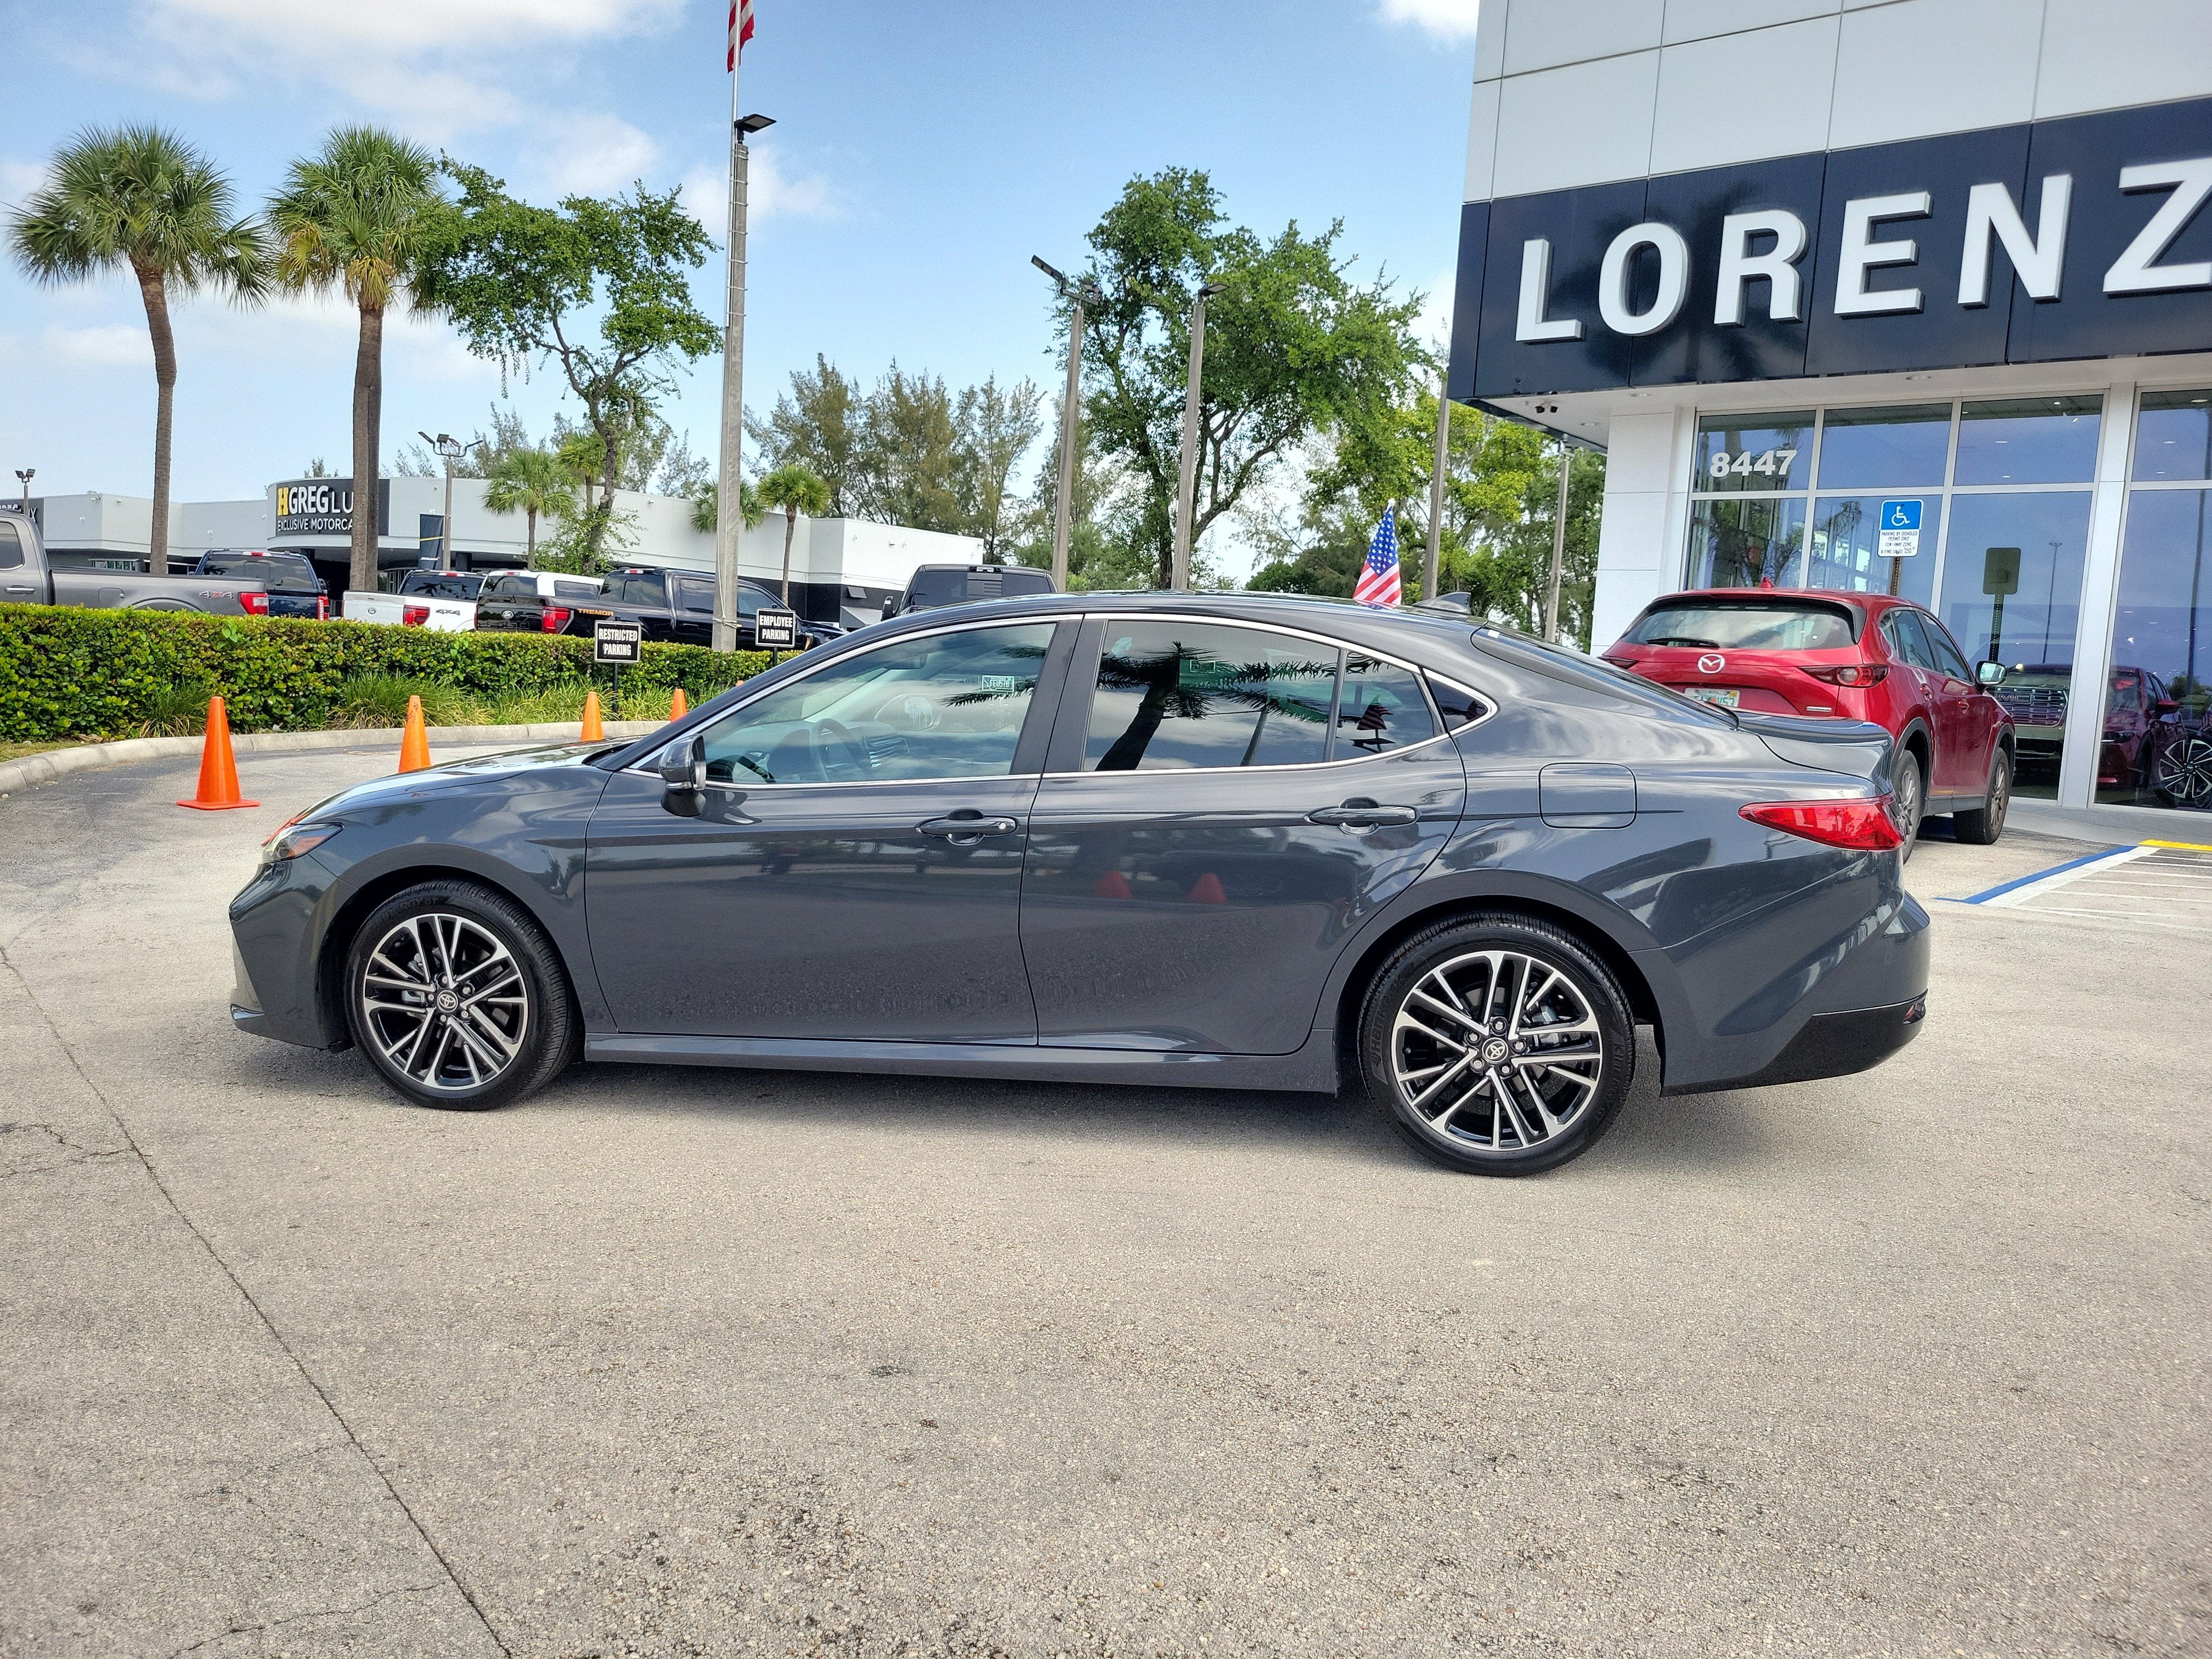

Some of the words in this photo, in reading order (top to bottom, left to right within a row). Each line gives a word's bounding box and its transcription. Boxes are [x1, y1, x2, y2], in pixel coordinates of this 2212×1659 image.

[1515, 157, 2212, 342] LORENZ
[1709, 450, 1797, 477] 8447
[278, 518, 308, 531] EXCLUSIVE
[577, 608, 614, 616] TREMOR
[759, 614, 793, 628] EMPLOYEE
[599, 628, 637, 641] RESTRICTED
[762, 628, 789, 641] PARKING
[603, 643, 631, 656] PARKING
